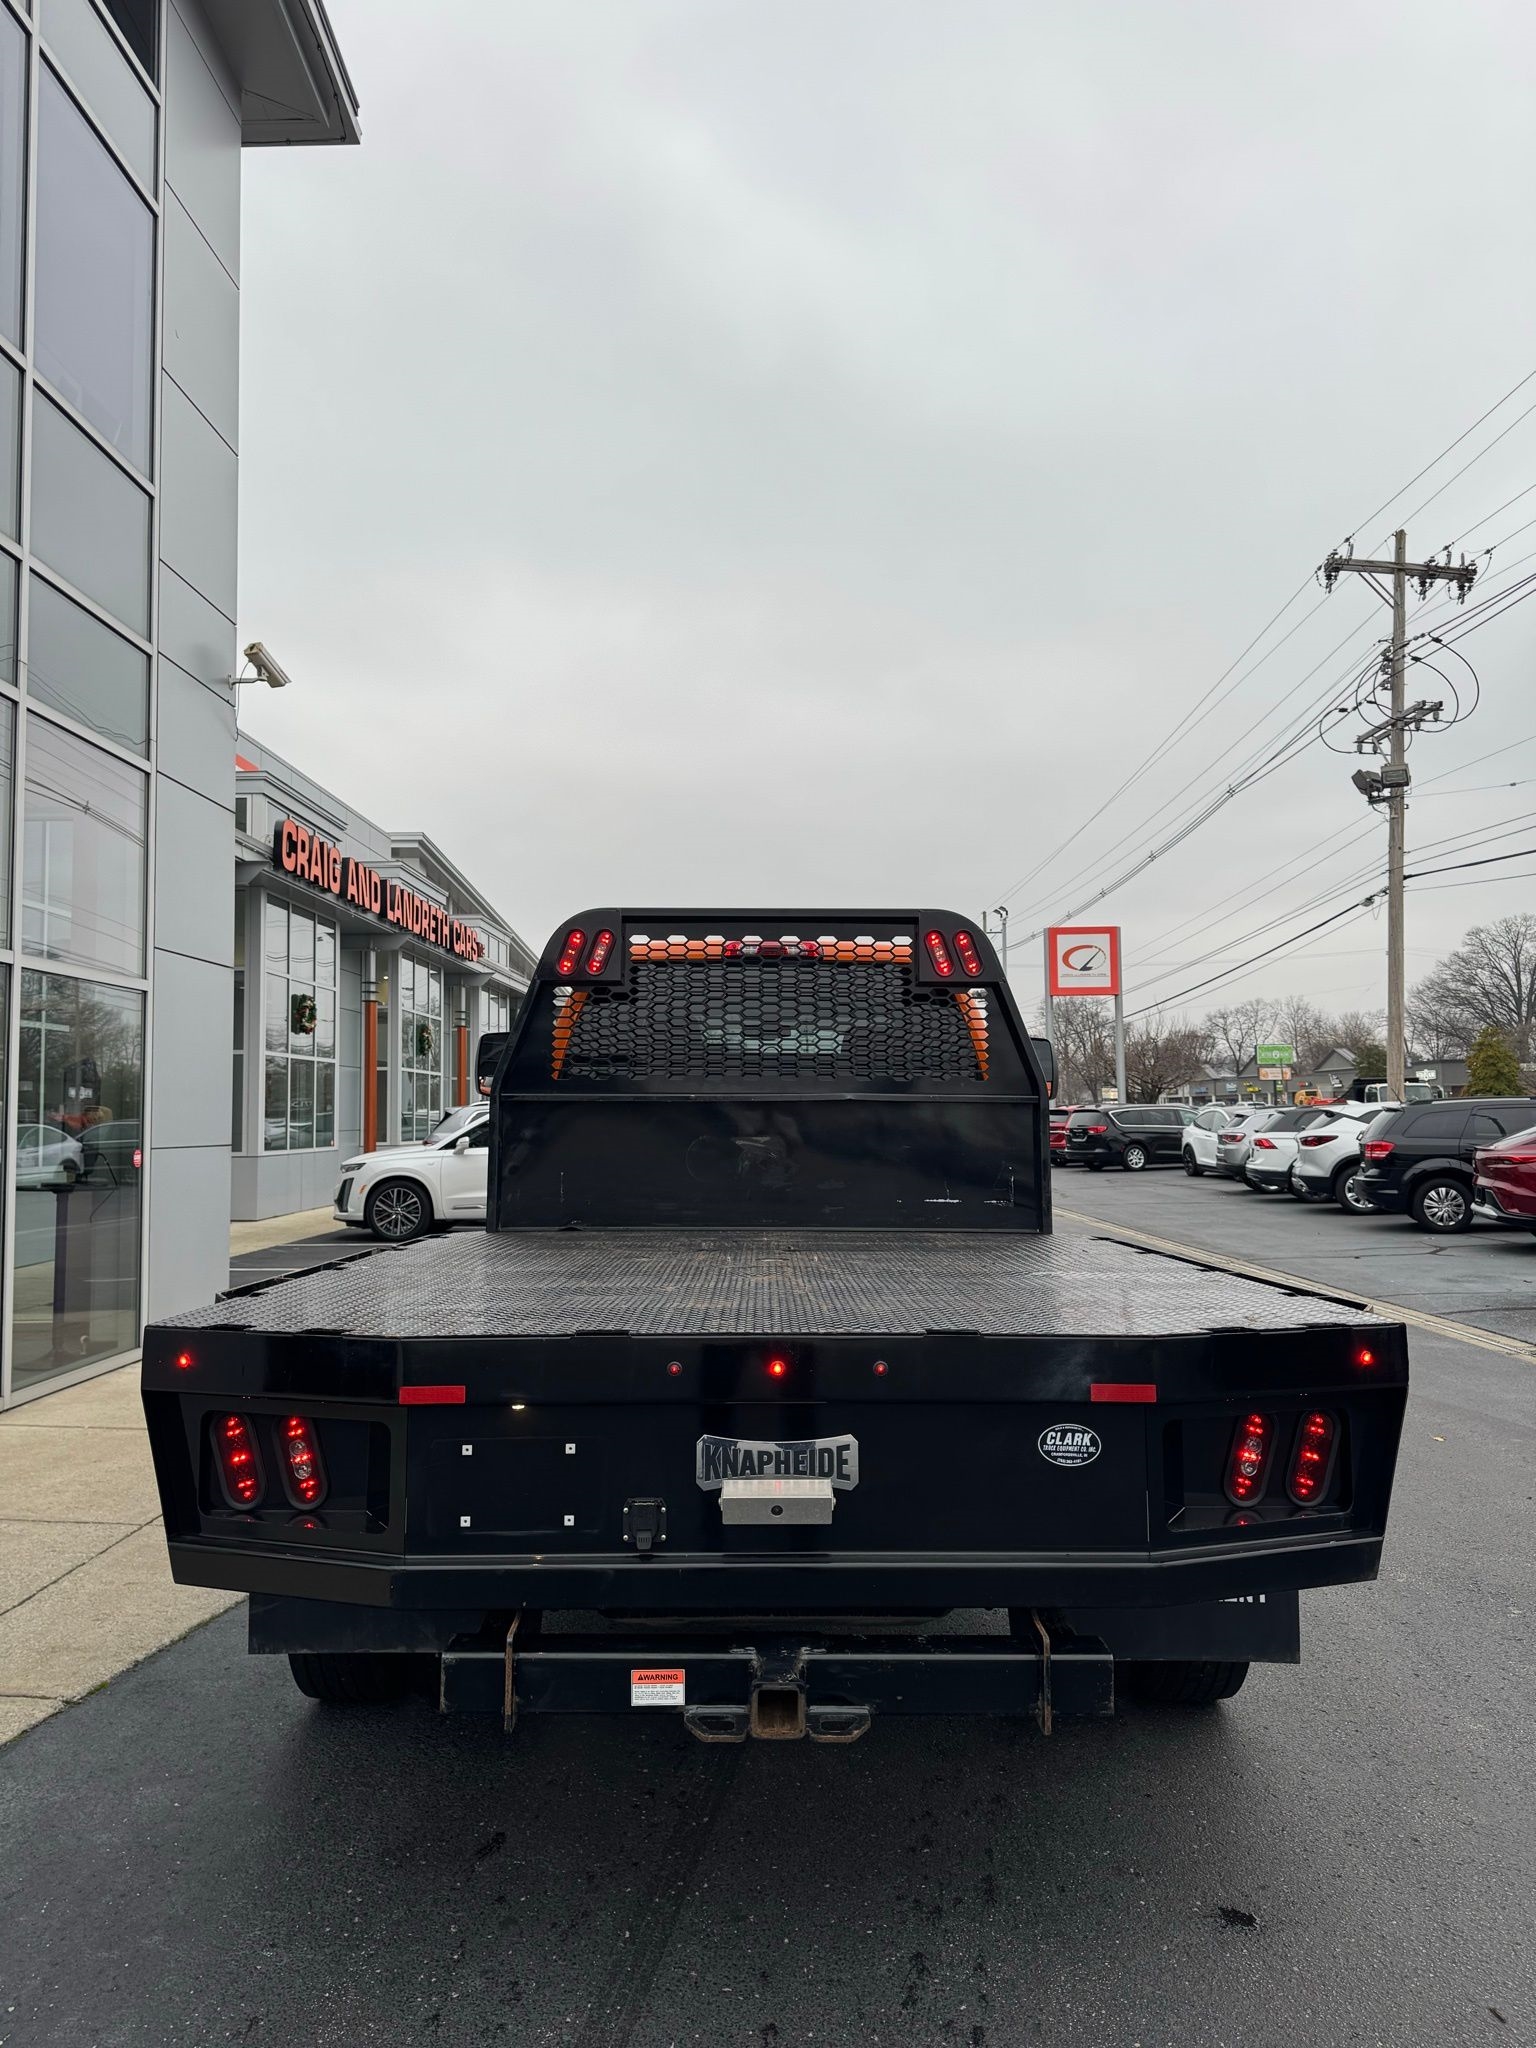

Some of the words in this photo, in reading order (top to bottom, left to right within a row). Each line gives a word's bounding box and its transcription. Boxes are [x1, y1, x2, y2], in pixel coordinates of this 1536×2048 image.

[281, 819, 341, 894] CRAIG
[347, 858, 381, 914] AND
[387, 880, 450, 948] LANDRETH
[453, 920, 477, 962] CARS
[1046, 1432, 1093, 1446] CLARK
[704, 1444, 851, 1482] KNAPHEIDE
[643, 1673, 678, 1681] WARNING
